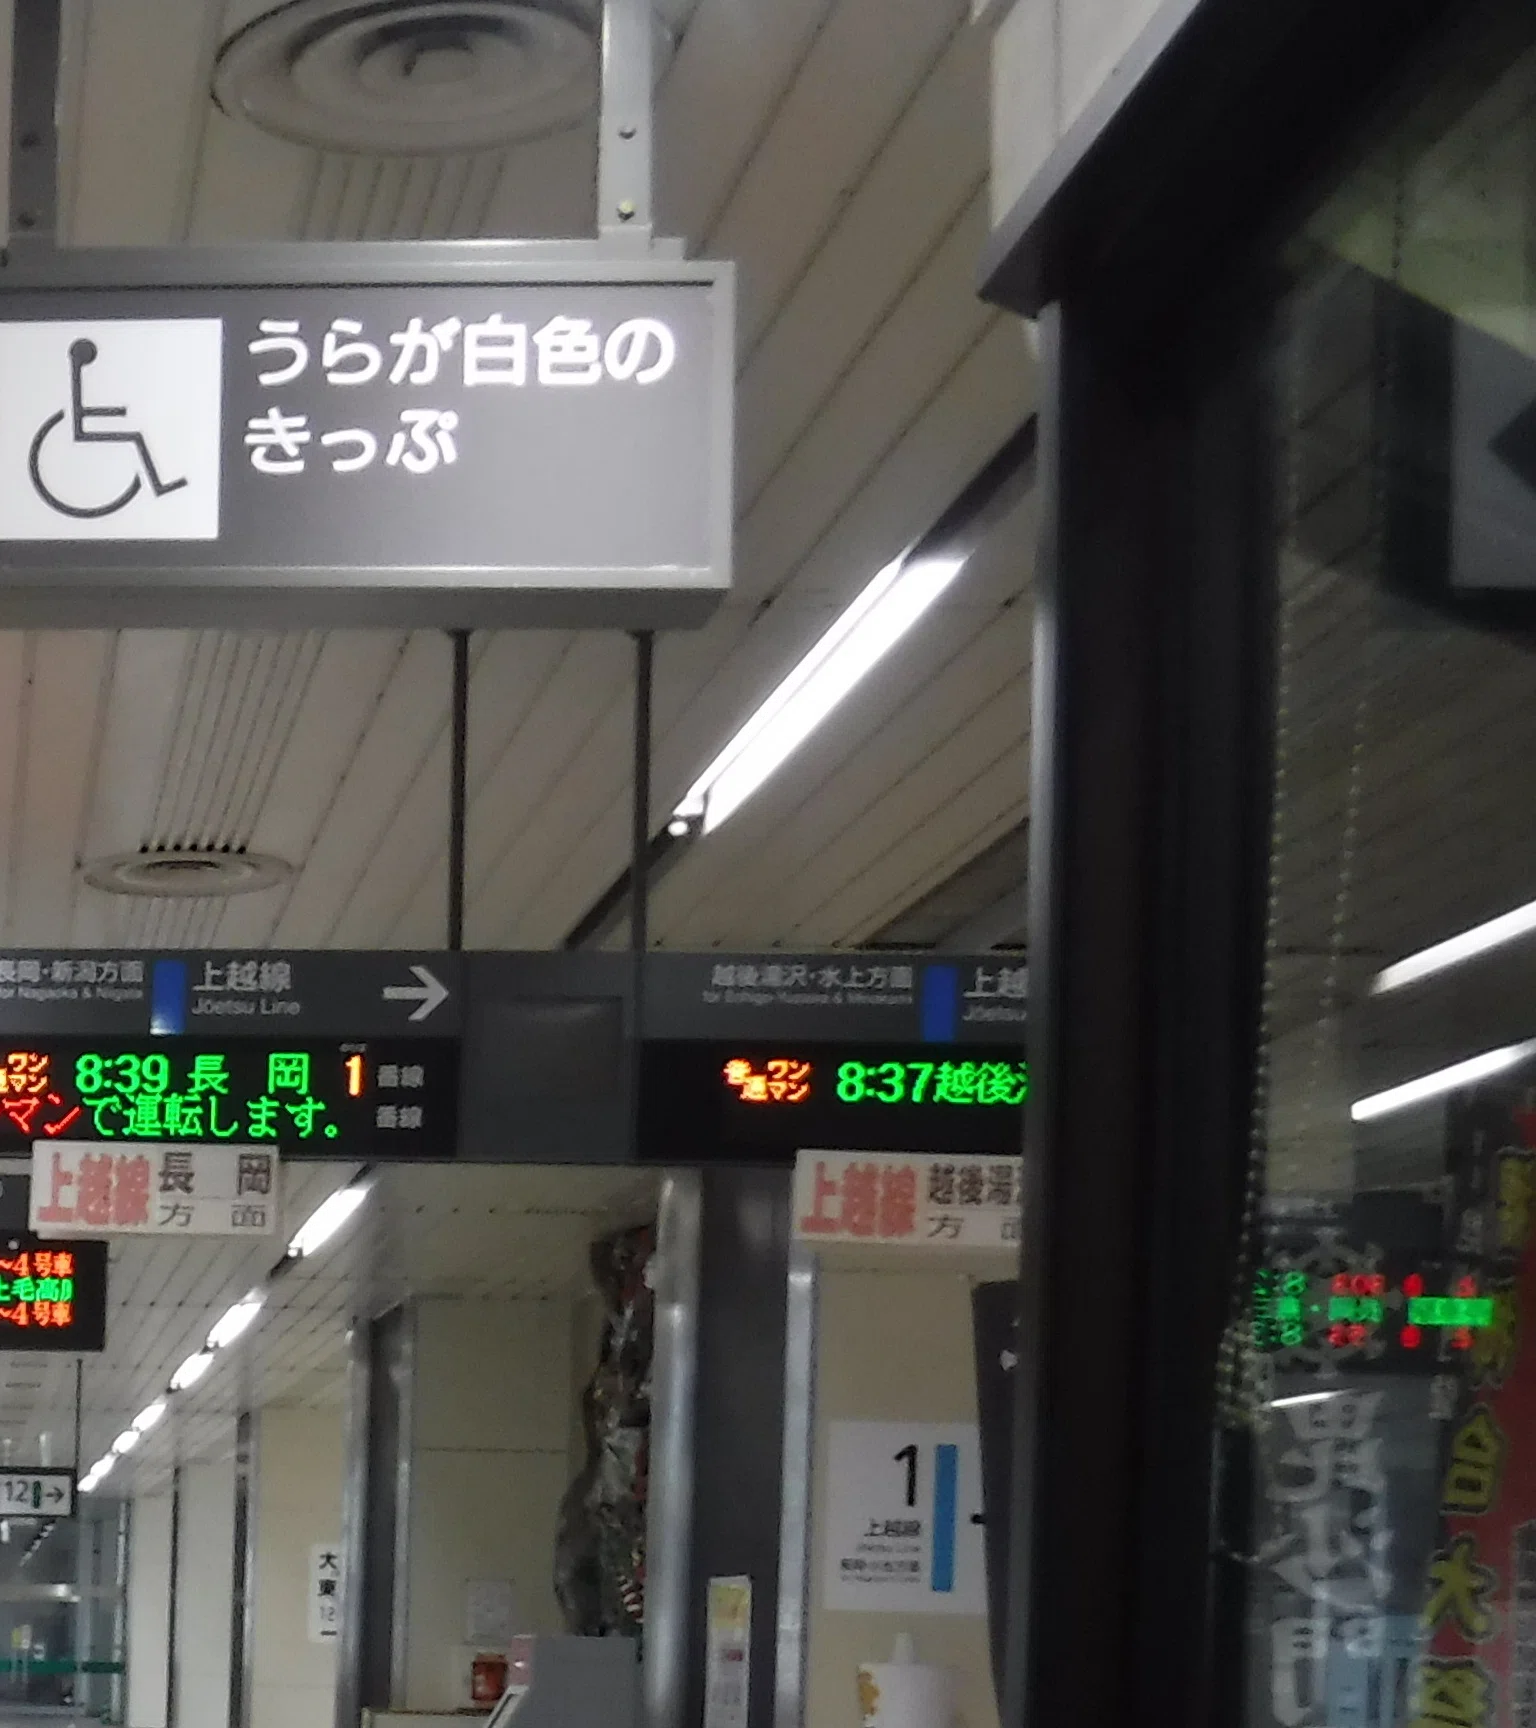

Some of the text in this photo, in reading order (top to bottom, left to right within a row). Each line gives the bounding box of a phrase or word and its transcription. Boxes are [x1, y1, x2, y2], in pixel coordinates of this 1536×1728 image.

[246, 314, 676, 390] うらが白色の
[242, 405, 458, 476] きっぷ
[191, 960, 292, 993] 上越線
[74, 1054, 170, 1094] 8:39
[343, 1054, 363, 1097] 1
[836, 1061, 934, 1103] 8:37
[37, 1152, 151, 1227] 上越線
[799, 1158, 918, 1237] 上越線
[893, 1444, 919, 1507] 1
